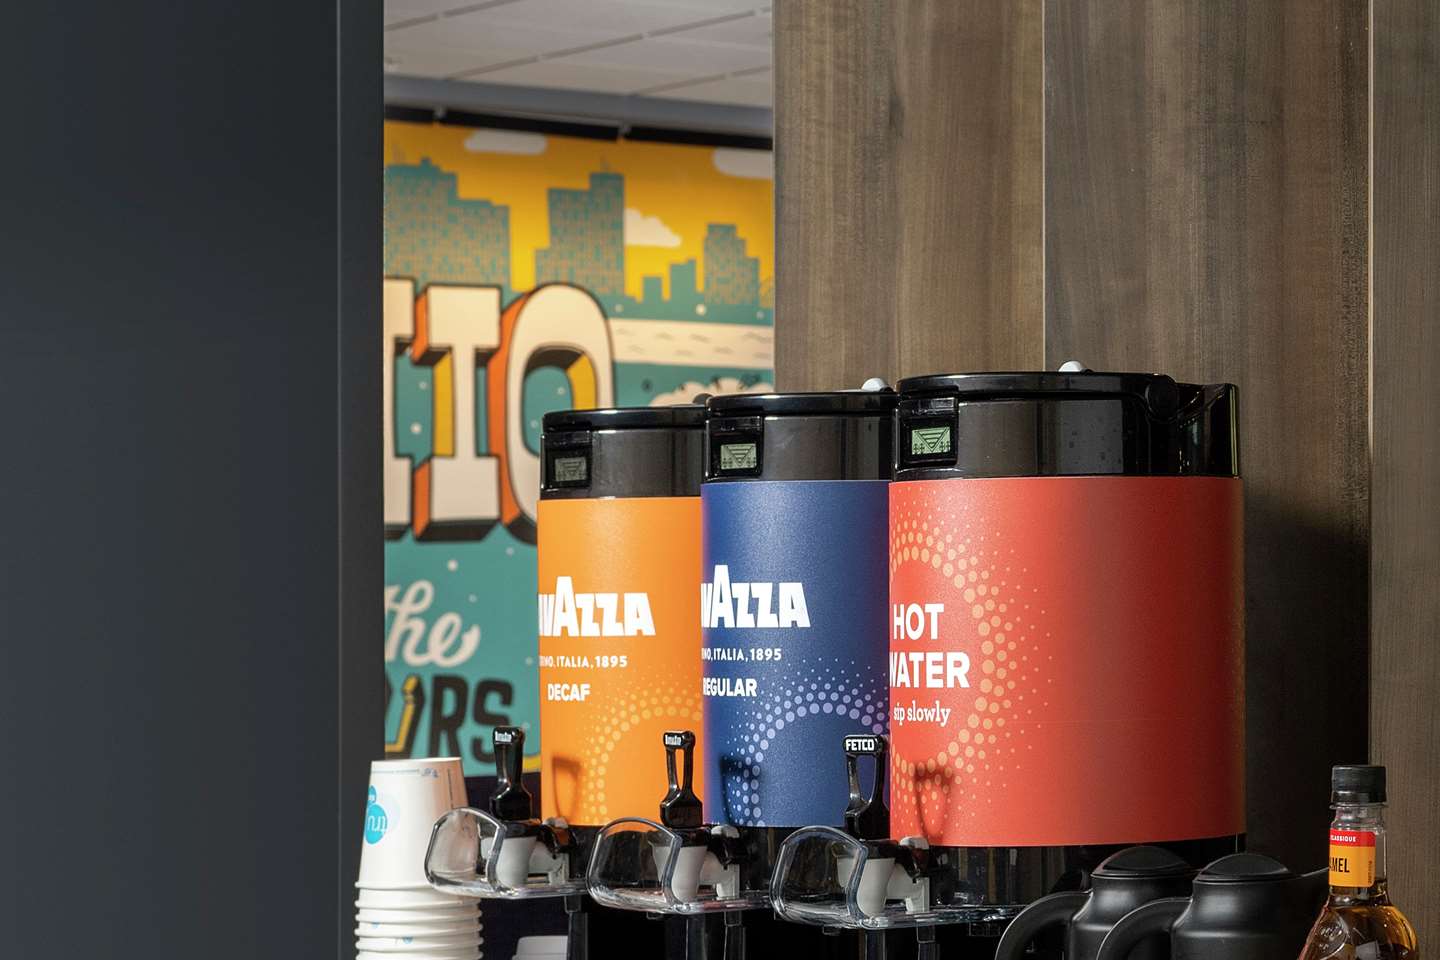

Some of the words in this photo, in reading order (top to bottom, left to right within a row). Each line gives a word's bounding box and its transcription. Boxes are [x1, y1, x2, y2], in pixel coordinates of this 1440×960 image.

[893, 603, 944, 640] HOT
[595, 655, 628, 668] 1895
[750, 648, 782, 661] 1895
[547, 683, 590, 701] DECAF
[893, 702, 905, 726] sip
[907, 700, 951, 727] slowly
[845, 739, 875, 751] FETCO
